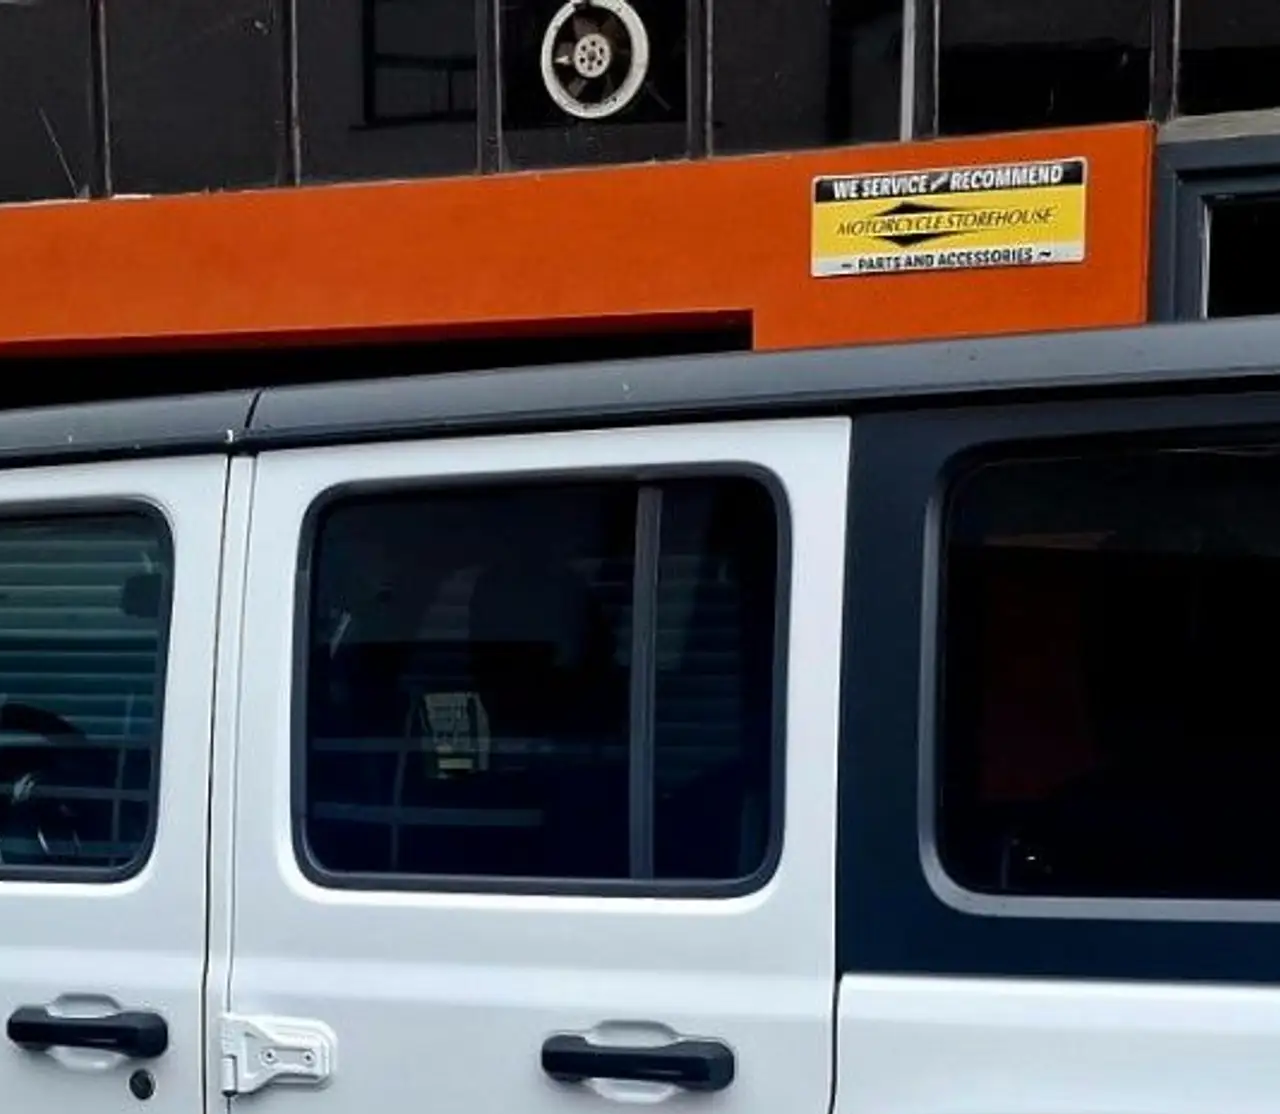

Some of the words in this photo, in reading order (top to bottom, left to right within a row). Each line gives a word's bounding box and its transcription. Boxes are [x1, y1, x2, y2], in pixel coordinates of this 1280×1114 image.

[833, 179, 859, 200] WE
[861, 175, 928, 198] SERVICE
[950, 164, 1064, 190] RECOMMEND
[836, 213, 944, 236] MOTORCYCLE
[945, 206, 1054, 229] STOREHOUSE
[858, 255, 901, 271] PARTS
[903, 253, 934, 269] AND
[937, 247, 1034, 267] ACCESSORIES
